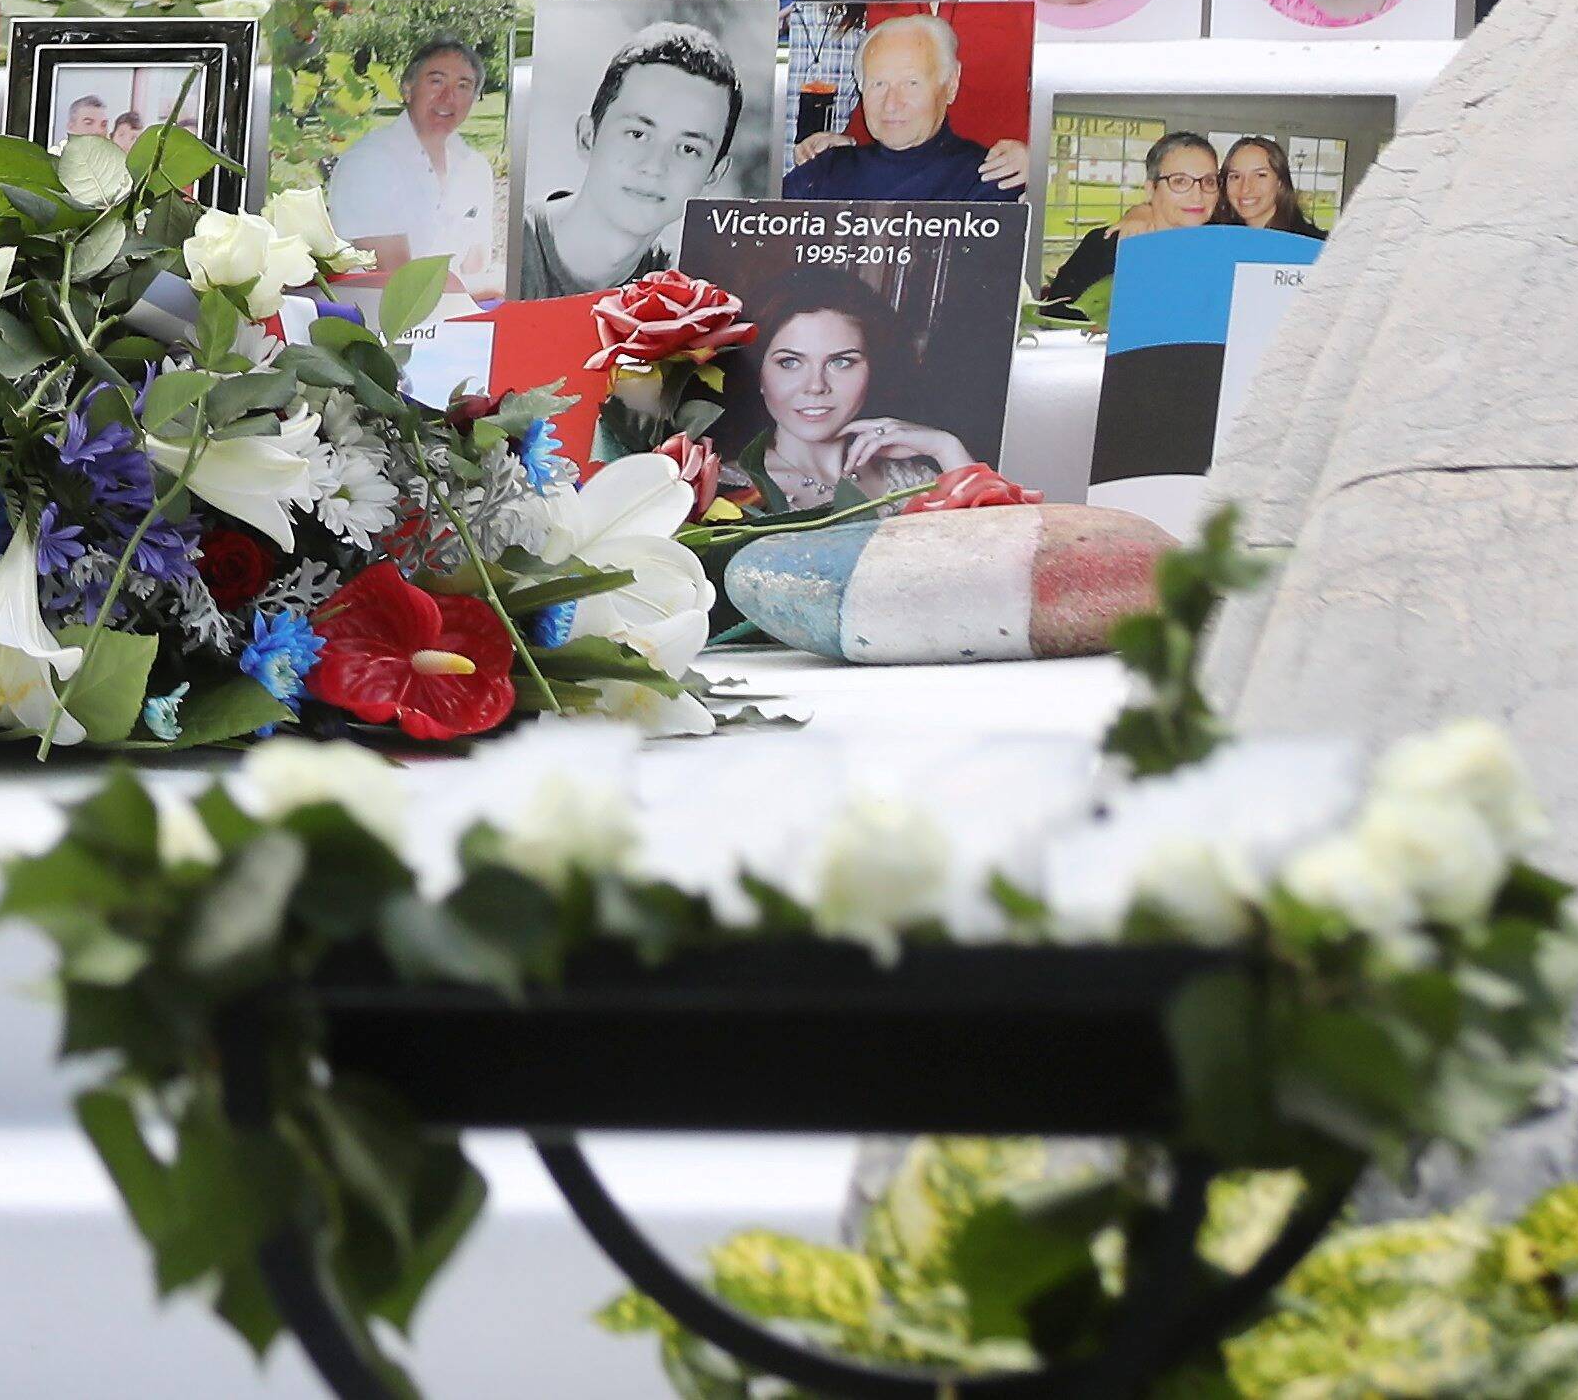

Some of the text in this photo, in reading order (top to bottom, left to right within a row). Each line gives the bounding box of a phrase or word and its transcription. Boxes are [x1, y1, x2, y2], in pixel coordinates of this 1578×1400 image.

[711, 208, 1000, 238] Victoria Savchenko
[795, 244, 912, 264] 1995-2016
